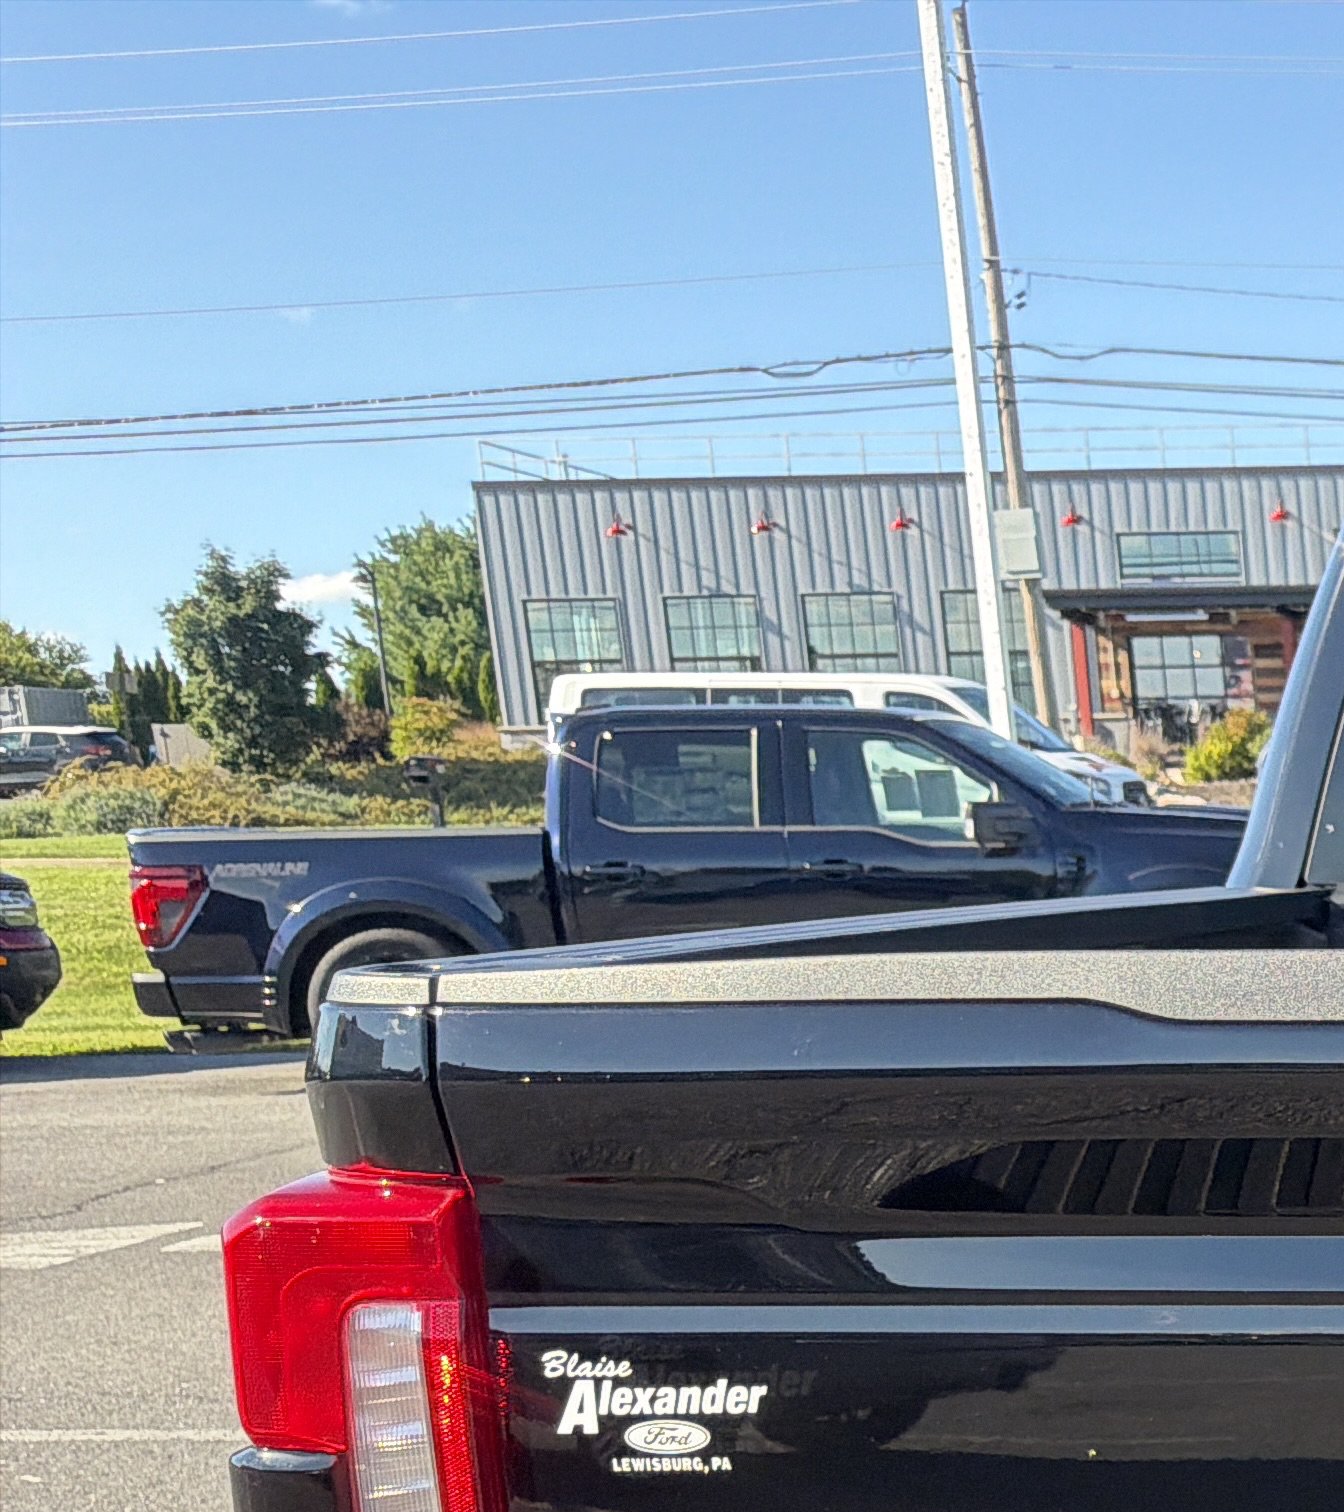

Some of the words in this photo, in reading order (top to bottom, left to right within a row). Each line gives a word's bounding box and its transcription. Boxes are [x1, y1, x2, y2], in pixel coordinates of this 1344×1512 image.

[541, 1350, 633, 1378] Blaise
[557, 1378, 768, 1434] Alexander
[644, 1427, 692, 1446] Ford
[612, 1457, 709, 1475] LEWISBURG,
[711, 1457, 732, 1471] PA
